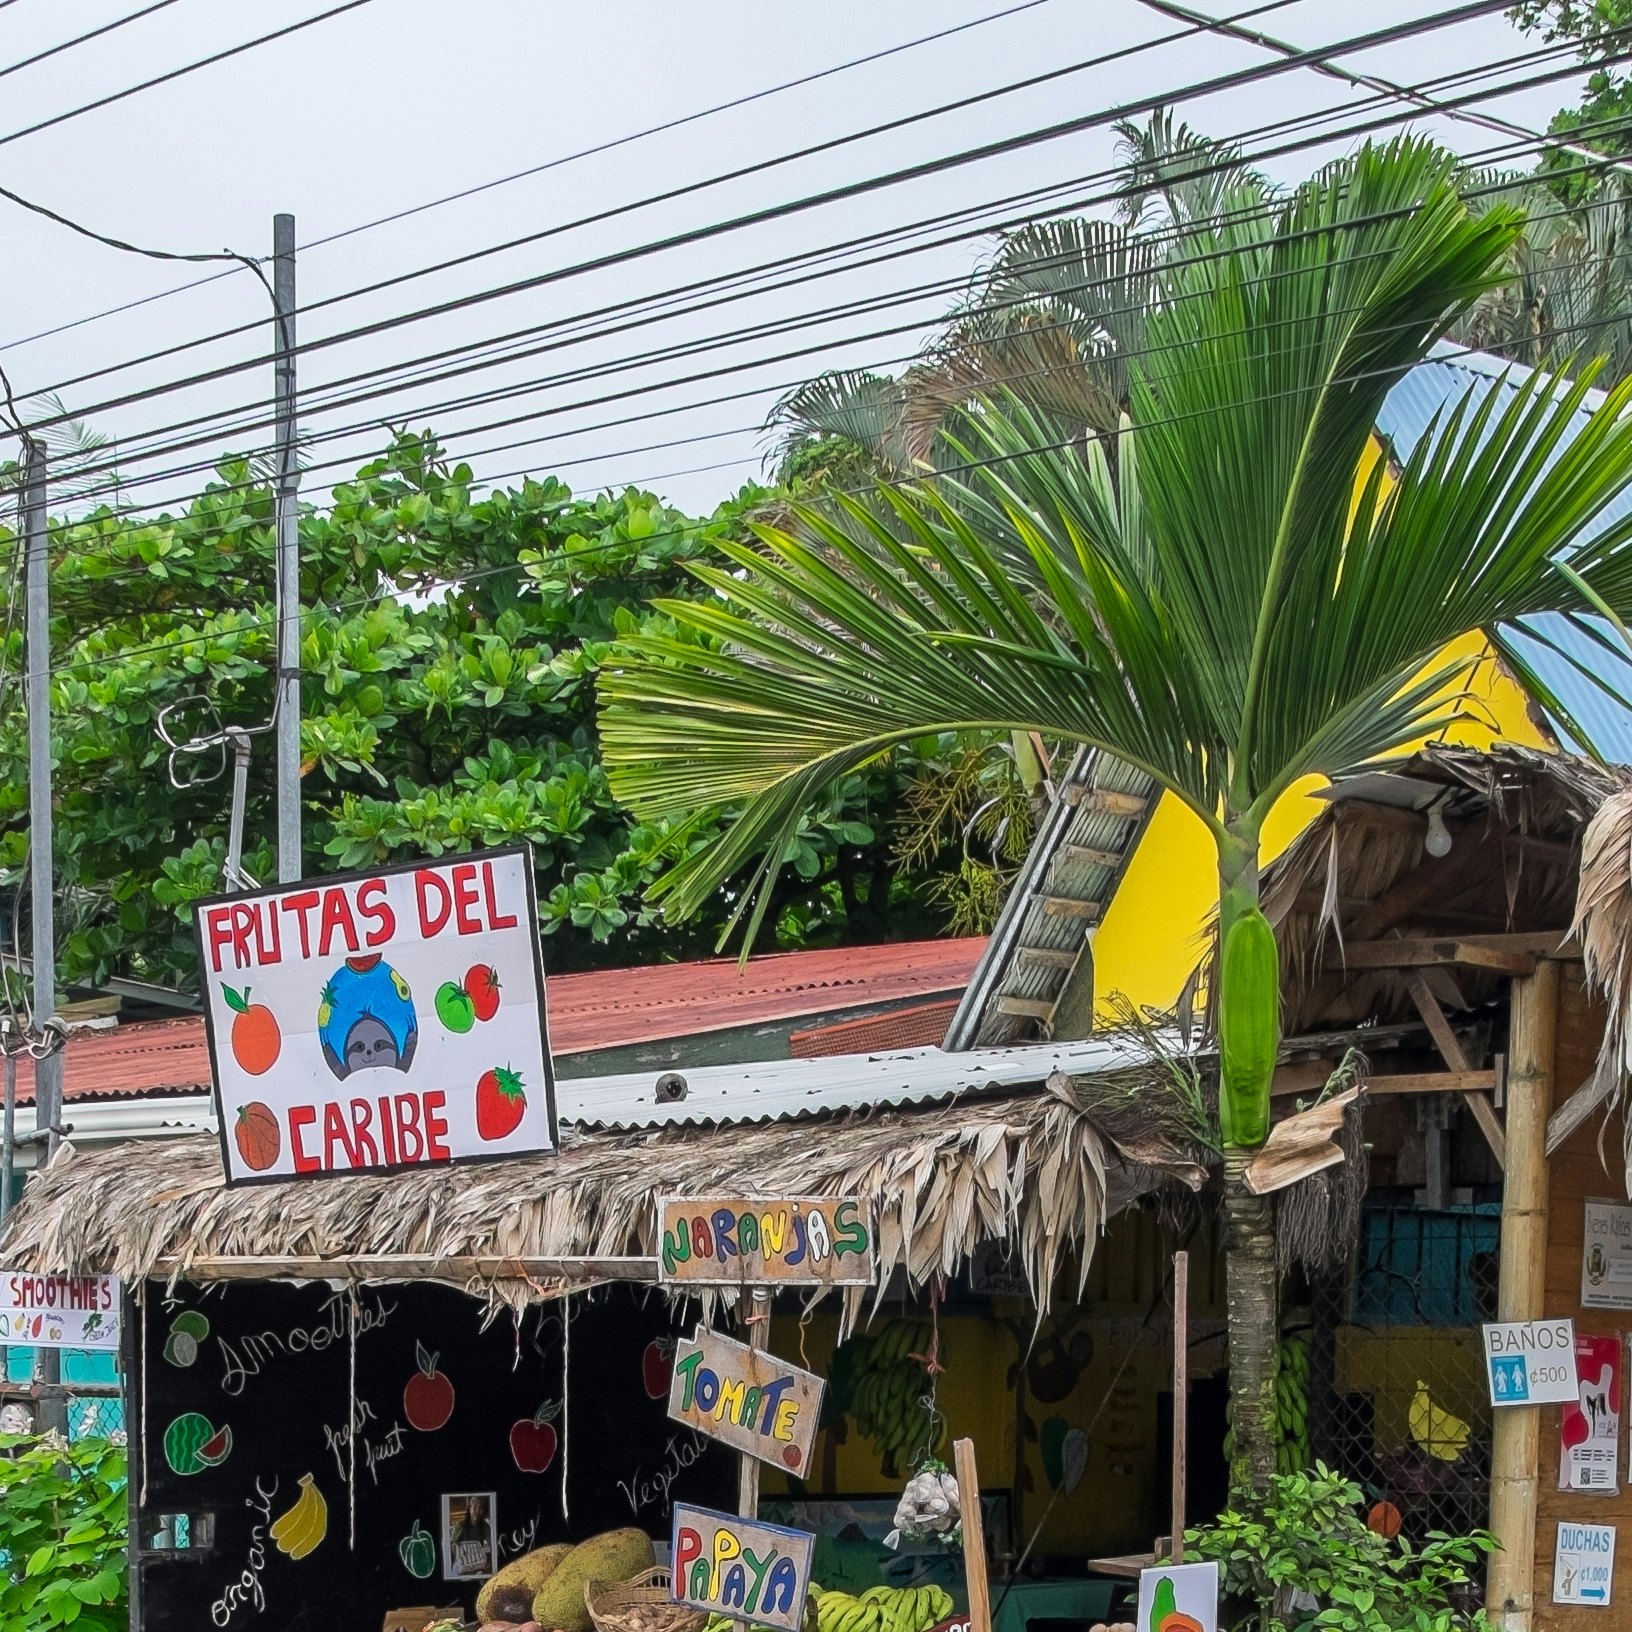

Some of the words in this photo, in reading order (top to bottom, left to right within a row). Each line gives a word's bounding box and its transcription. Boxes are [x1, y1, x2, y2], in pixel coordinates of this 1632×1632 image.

[206, 877, 397, 973] FRUTAS
[414, 861, 518, 939] DEL
[288, 1089, 451, 1174] CARIBE
[10, 1276, 112, 1311] SMOOTHIES
[1489, 1324, 1570, 1352] BAÑOS
[676, 1350, 800, 1442] TOMATE
[211, 1473, 279, 1628] organic
[676, 1527, 797, 1615] PAPAYA
[1560, 1528, 1610, 1553] DUCHAS
